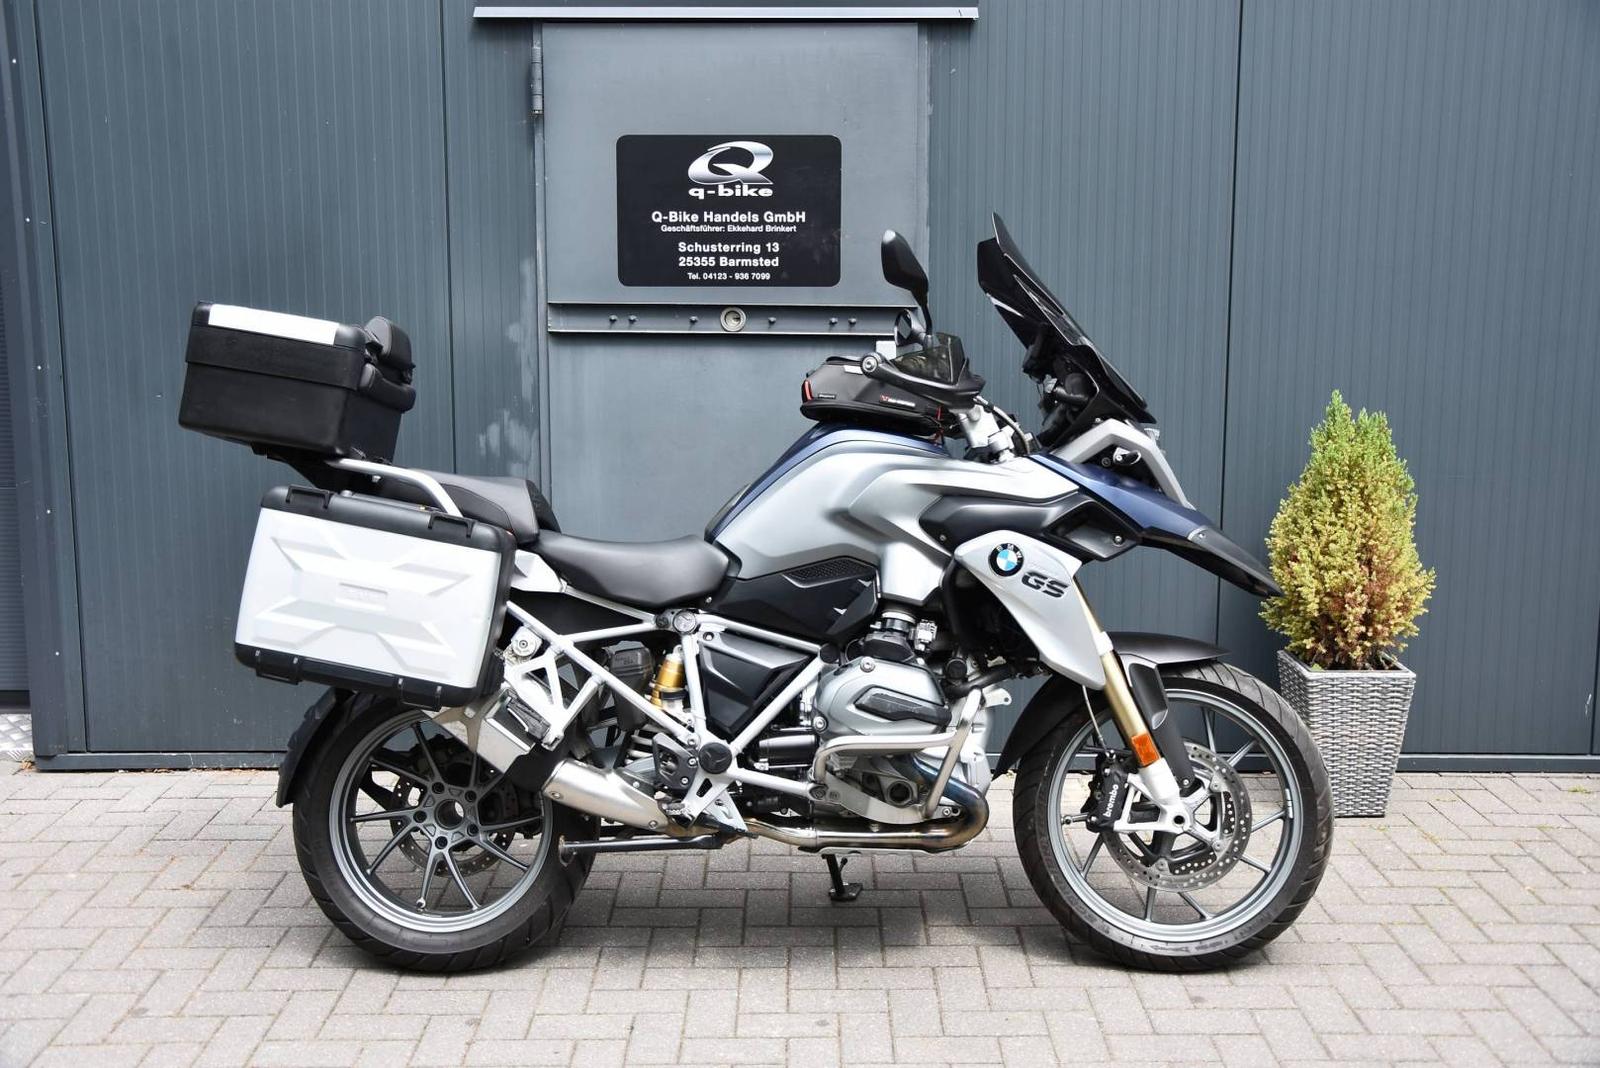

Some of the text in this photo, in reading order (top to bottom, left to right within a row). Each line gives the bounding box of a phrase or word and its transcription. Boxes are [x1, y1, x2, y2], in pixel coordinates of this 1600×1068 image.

[688, 184, 774, 200] q-bike
[651, 210, 806, 223] Q-Bike Handels GmbH
[660, 224, 797, 233] Geschäftsführer: Ekkehard Brinkert
[677, 241, 780, 255] Schusterring 13
[678, 256, 780, 267] 25355 Barmsted
[687, 272, 701, 281] Tel.
[703, 272, 728, 281] 04123
[734, 272, 750, 281] 936
[751, 272, 771, 281] 7099
[1021, 570, 1070, 598] GS
[1102, 784, 1119, 818] brembo
